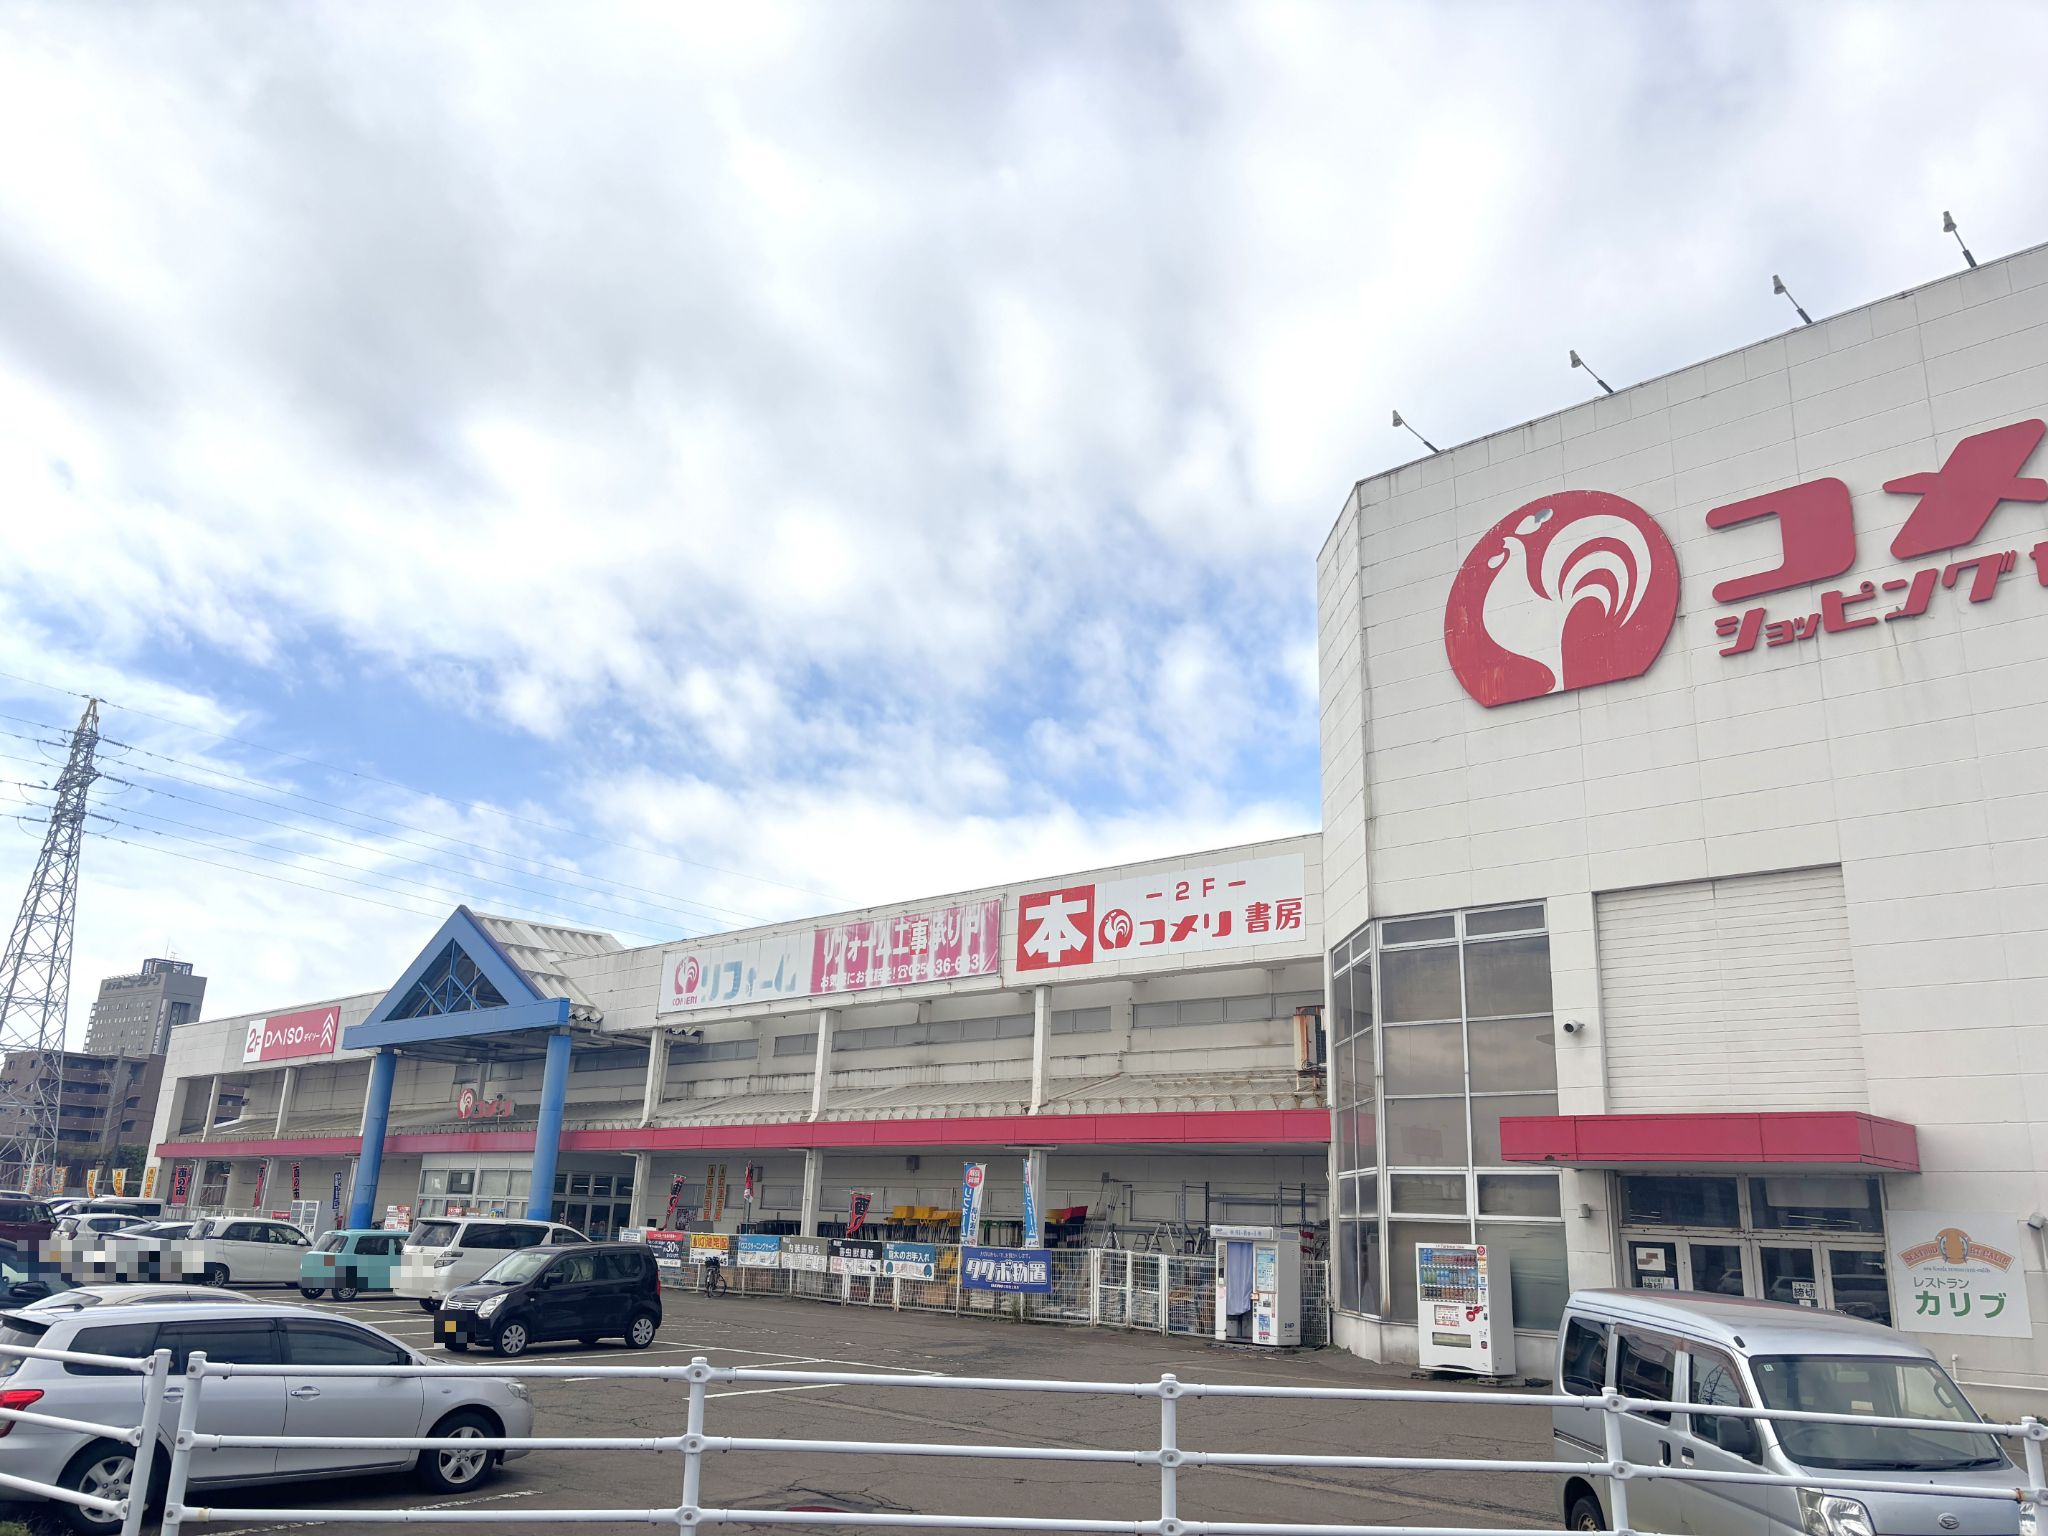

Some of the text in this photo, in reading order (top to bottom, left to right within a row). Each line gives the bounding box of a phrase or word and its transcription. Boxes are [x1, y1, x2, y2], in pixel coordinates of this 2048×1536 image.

[1024, 895, 1088, 963] 本
[247, 1028, 262, 1053] 2F
[264, 1026, 304, 1048] DAISO
[966, 1259, 1047, 1284] タクボ物置
[1913, 1277, 1969, 1289] レストラン
[1915, 1290, 2007, 1319] カリブ
